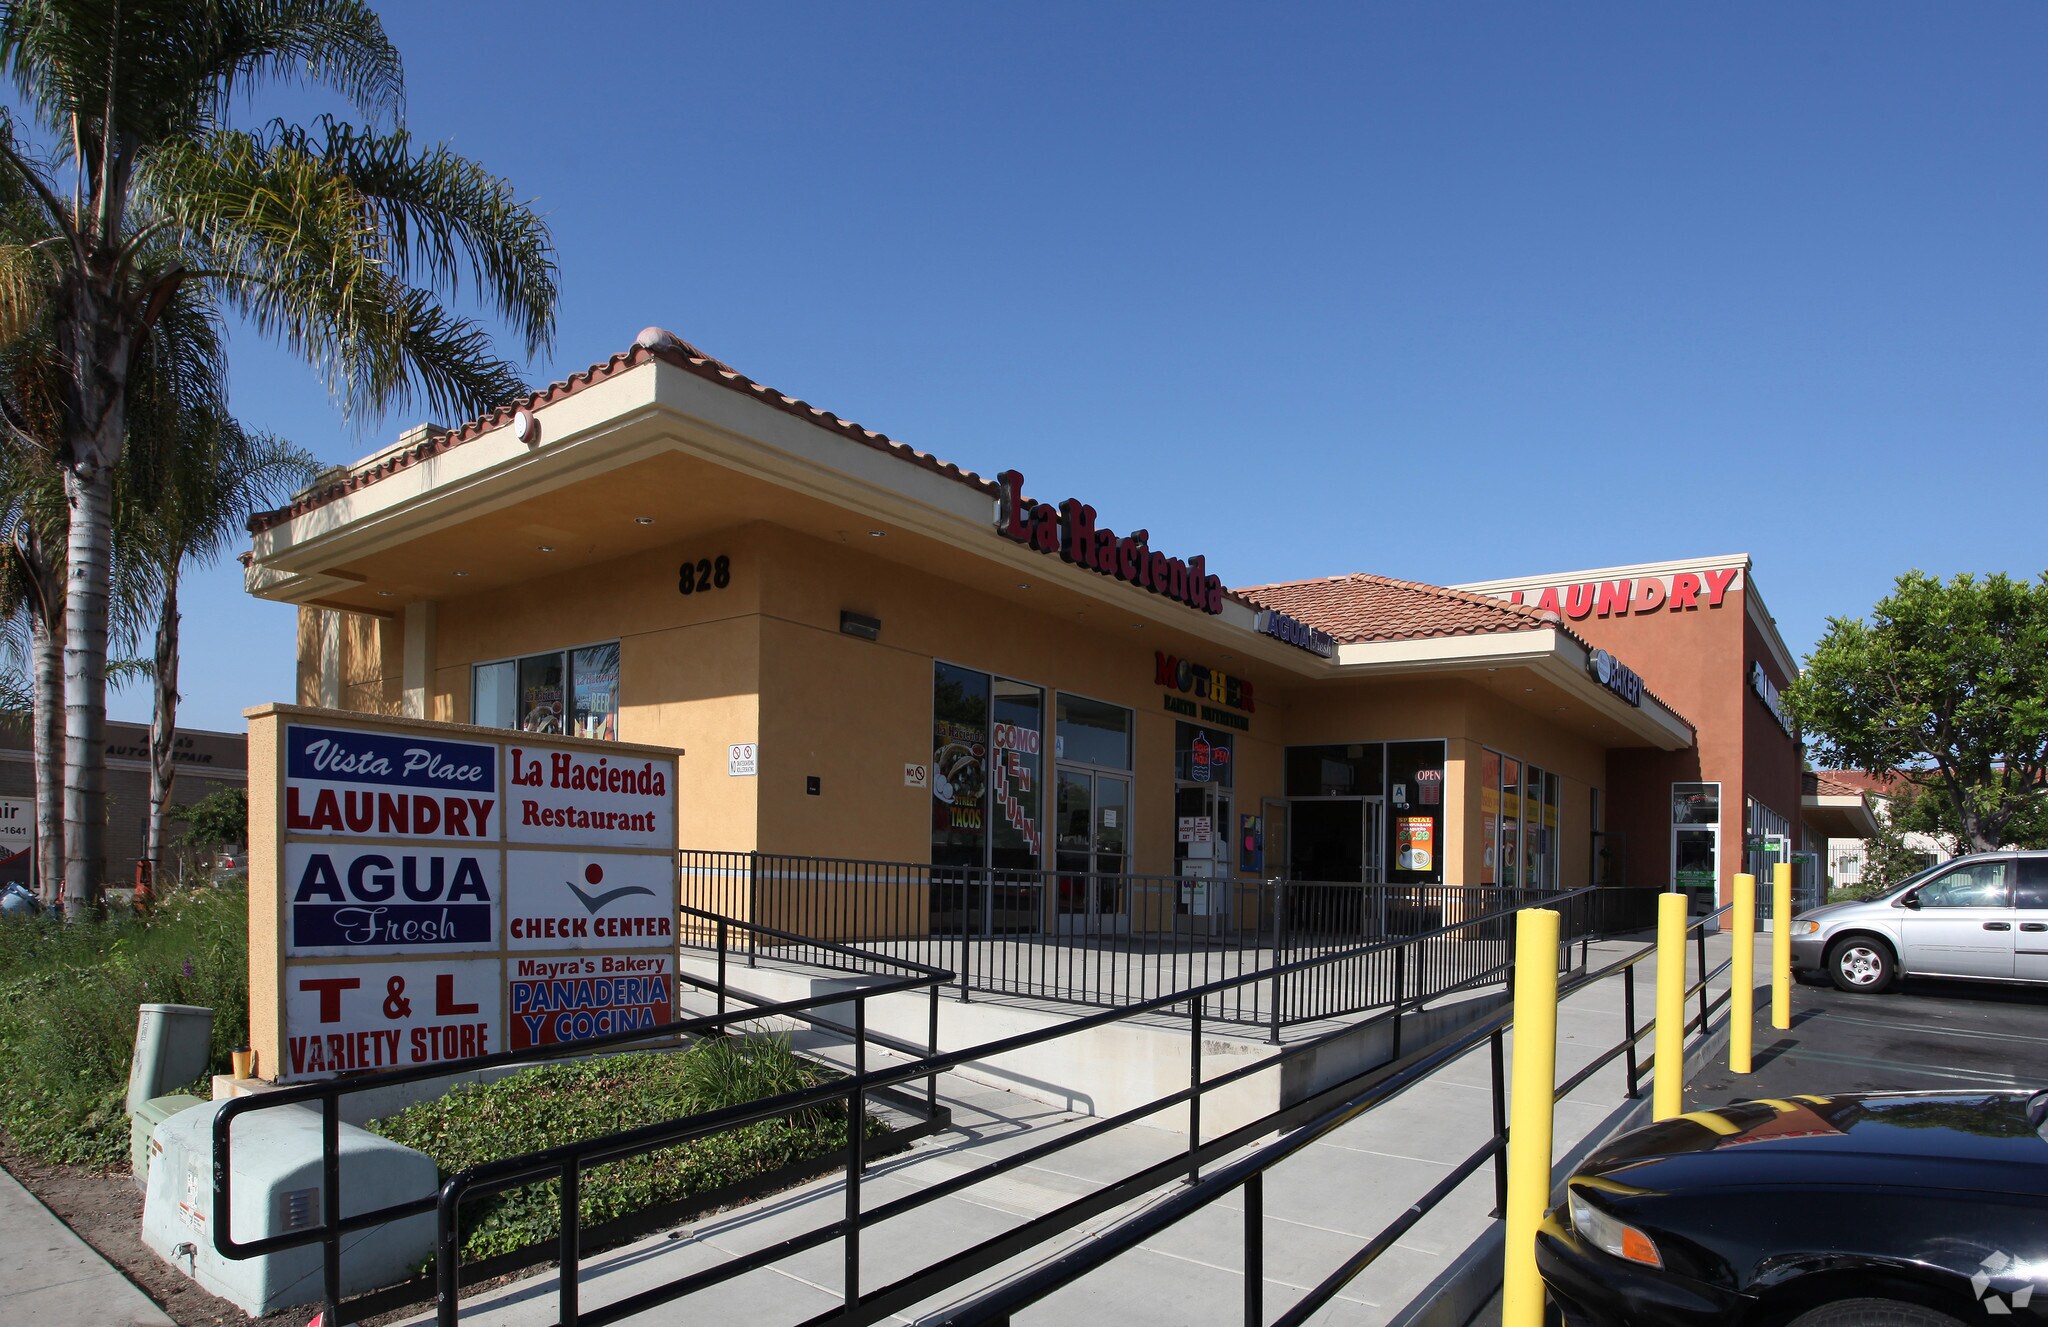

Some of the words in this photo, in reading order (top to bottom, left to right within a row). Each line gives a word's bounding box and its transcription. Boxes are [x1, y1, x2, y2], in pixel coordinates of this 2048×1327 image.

[997, 469, 1060, 554] La
[1059, 498, 1223, 615] Hacienda
[679, 555, 730, 595] 828
[1266, 610, 1310, 651] AGUA
[1310, 629, 1332, 656] Fresh
[1155, 651, 1255, 713] MOTHER
[1610, 655, 1644, 706] BAKERY
[591, 692, 609, 712] BEER
[936, 724, 946, 736] La
[948, 725, 985, 743] Hacienda
[994, 724, 1038, 754] COMO
[105, 745, 148, 757] AUTO
[172, 751, 213, 763] EPAIR
[305, 739, 392, 776] Vista
[402, 748, 482, 782] Place
[906, 768, 914, 777] NO
[1009, 753, 1029, 790] EN
[511, 749, 543, 788] La
[551, 753, 666, 797] Hacienda
[1396, 787, 1403, 796] A
[1417, 770, 1440, 781] OPEN
[0, 803, 19, 819] ir
[286, 787, 495, 837] LAUNDRY
[522, 800, 656, 832] Restaurant
[951, 809, 981, 828] TACOS
[955, 797, 977, 806] STREET
[1399, 831, 1430, 842] $1.99
[293, 854, 491, 903] AGUA
[334, 906, 456, 944] Fresh
[511, 918, 587, 939] CHECK
[594, 917, 671, 938] CENTER
[518, 958, 595, 979] Mayra's
[601, 956, 665, 974] Bakery
[299, 978, 360, 1023] T
[382, 976, 412, 1020] &
[436, 974, 479, 1016] L
[513, 976, 668, 1014] PANADERIA
[523, 1014, 547, 1045] Y
[555, 1007, 656, 1041] COCINA
[289, 1028, 402, 1075] VARIETY
[411, 1023, 489, 1062] STORE
